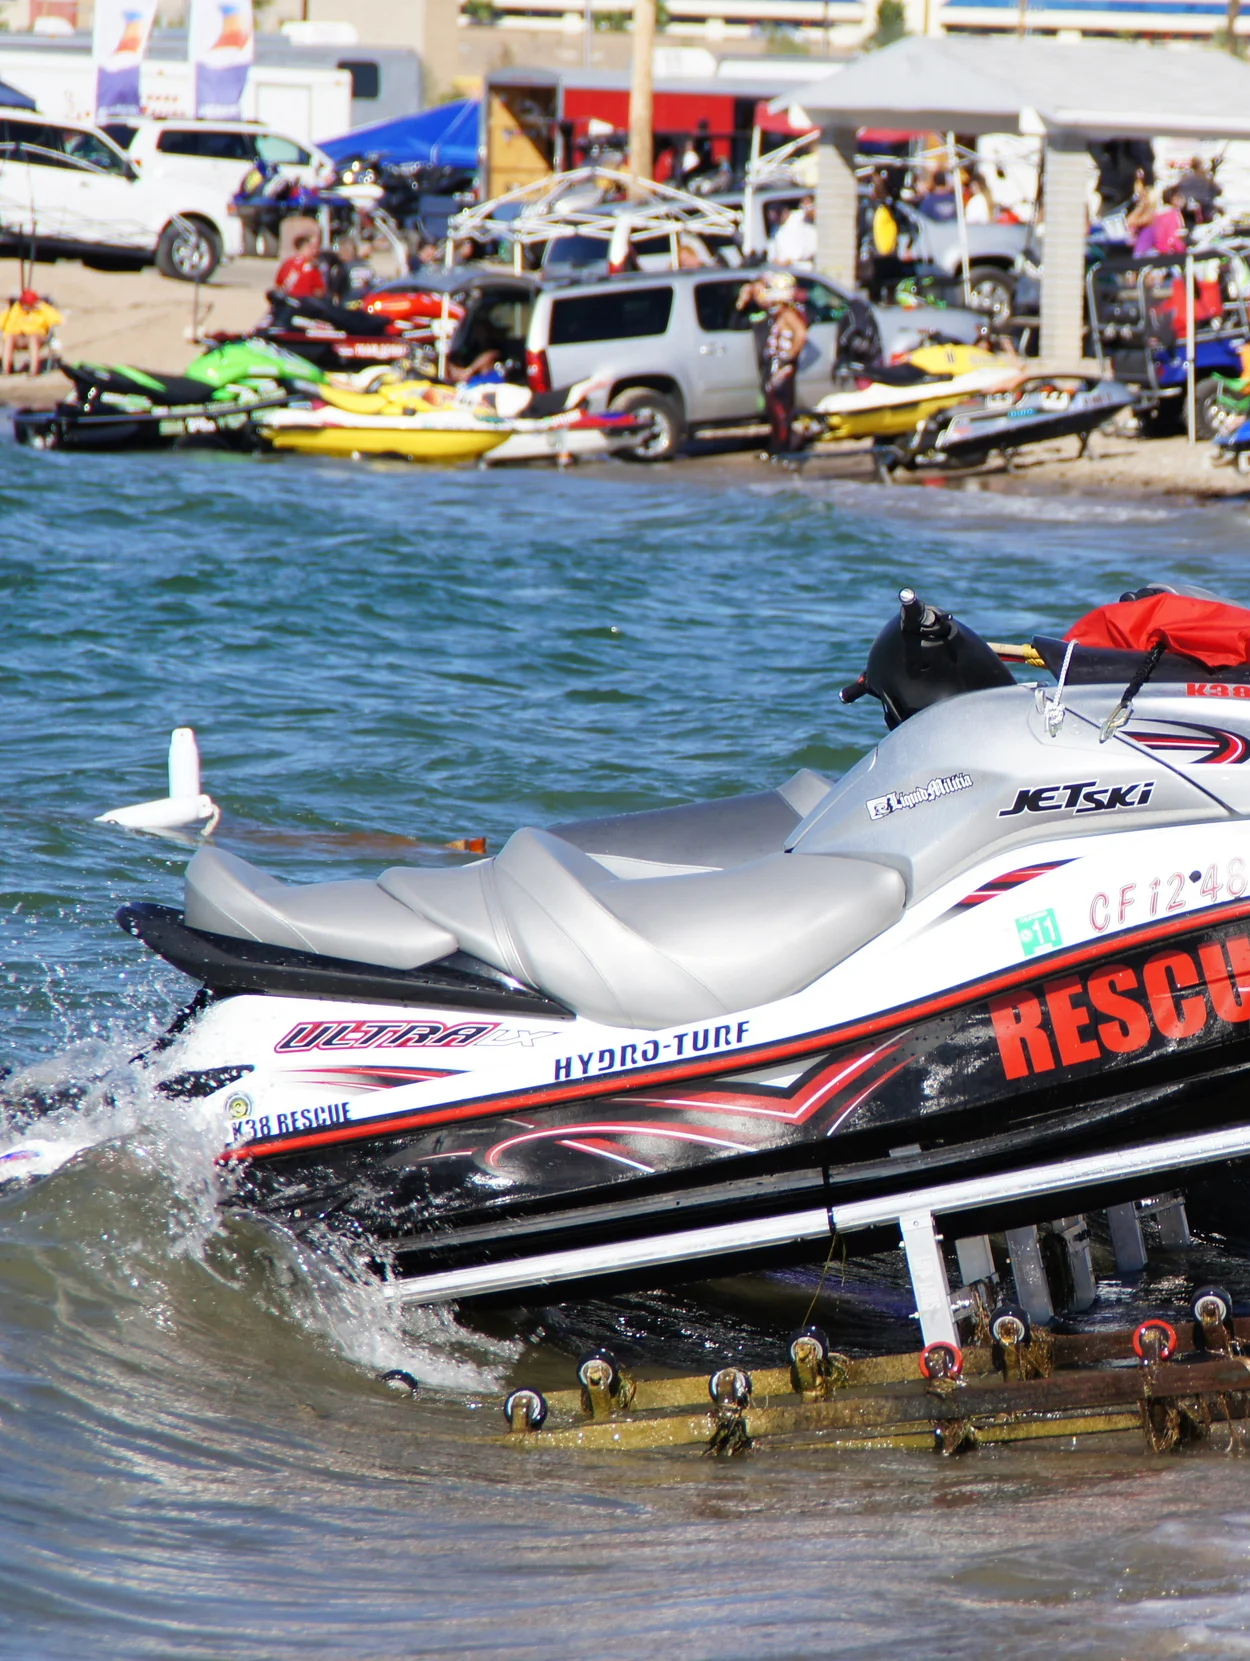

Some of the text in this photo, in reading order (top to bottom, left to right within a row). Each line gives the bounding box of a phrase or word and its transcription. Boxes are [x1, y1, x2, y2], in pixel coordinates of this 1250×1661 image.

[1032, 916, 1057, 945] 11
[274, 1020, 502, 1053] ULTRA
[554, 1020, 750, 1081] HYDRO-TURF
[276, 1101, 351, 1135] RESCUE
